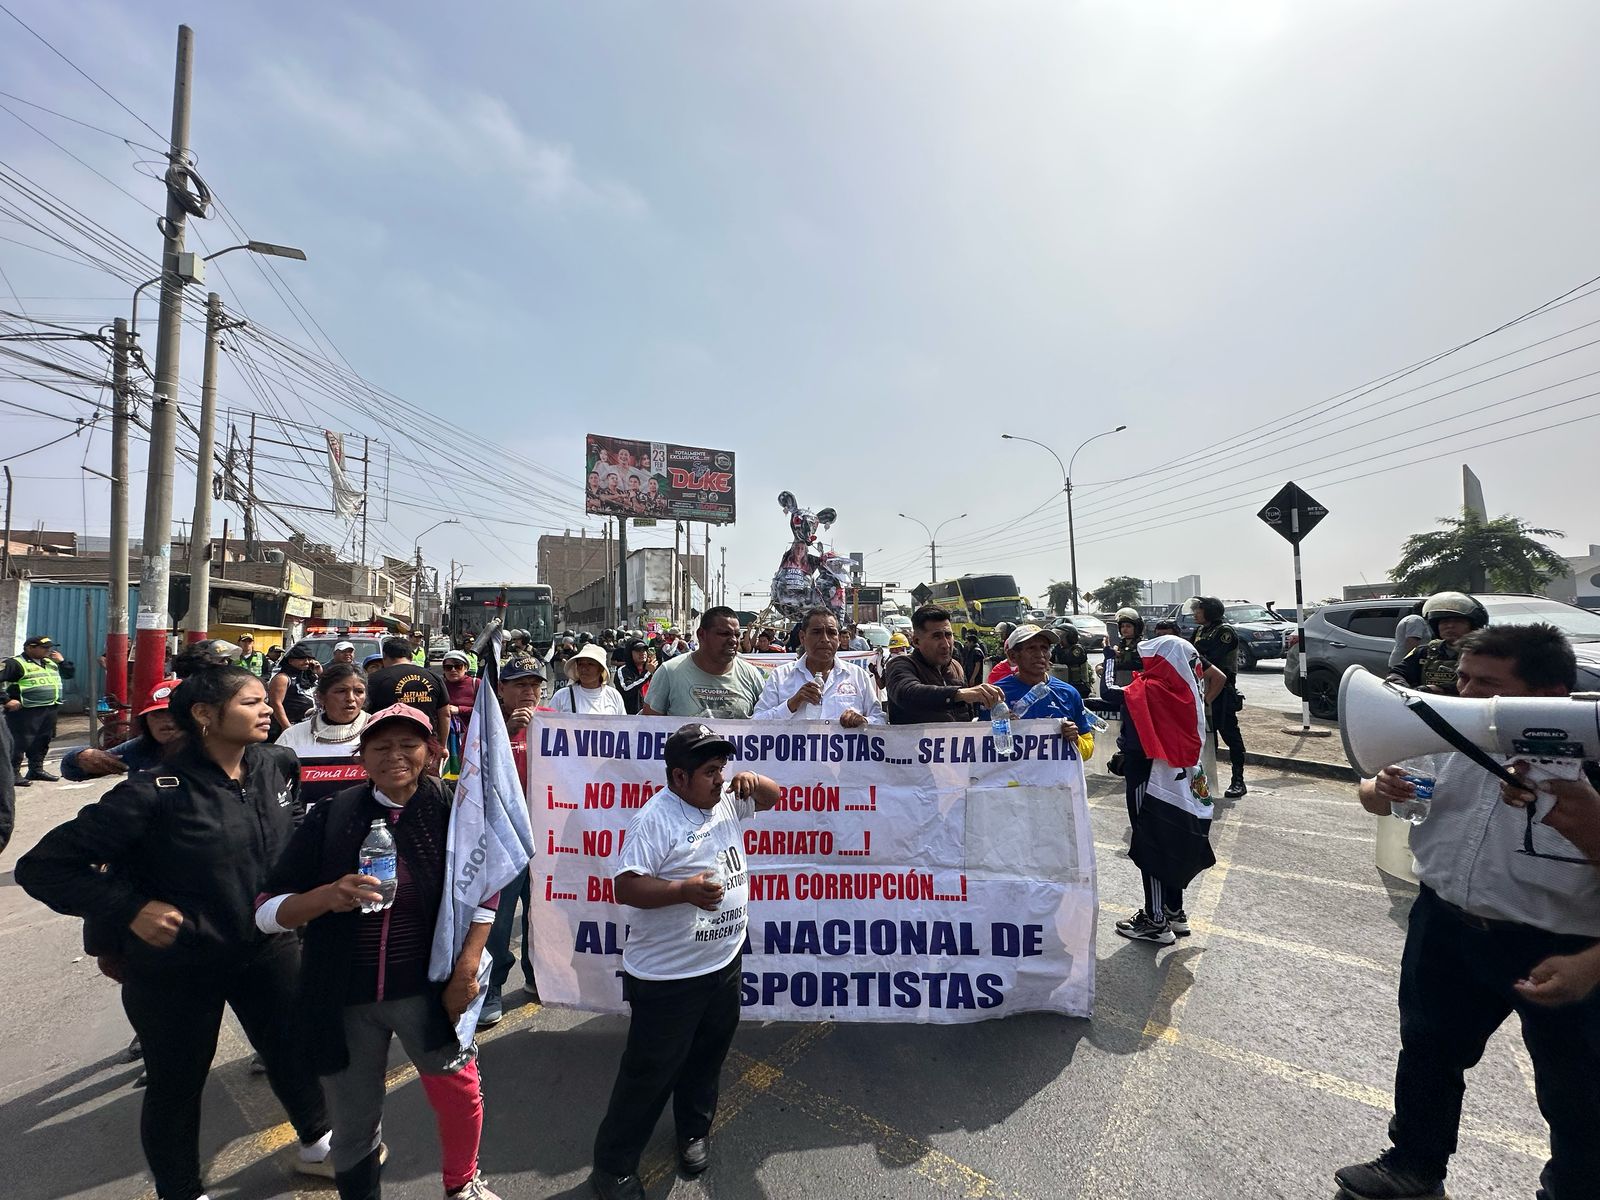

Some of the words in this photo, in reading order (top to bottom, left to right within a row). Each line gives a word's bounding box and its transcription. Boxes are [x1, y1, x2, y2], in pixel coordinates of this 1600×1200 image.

[653, 450, 665, 462] 23
[668, 467, 733, 492] DUKE
[541, 727, 569, 757] LA
[574, 729, 631, 760] VIDA
[918, 737, 945, 764] SE
[950, 736, 976, 763] LA
[305, 768, 342, 779] Toma
[344, 767, 358, 778] la
[584, 782, 615, 809] NO
[621, 780, 665, 809] MÁ
[774, 782, 840, 812] RCIÓN
[583, 830, 613, 857] NO
[743, 829, 833, 856] CARIATO
[687, 831, 711, 844] Olivos
[695, 924, 734, 943] MERECEN
[764, 919, 980, 956] NACIONAL
[991, 922, 1043, 958] DE
